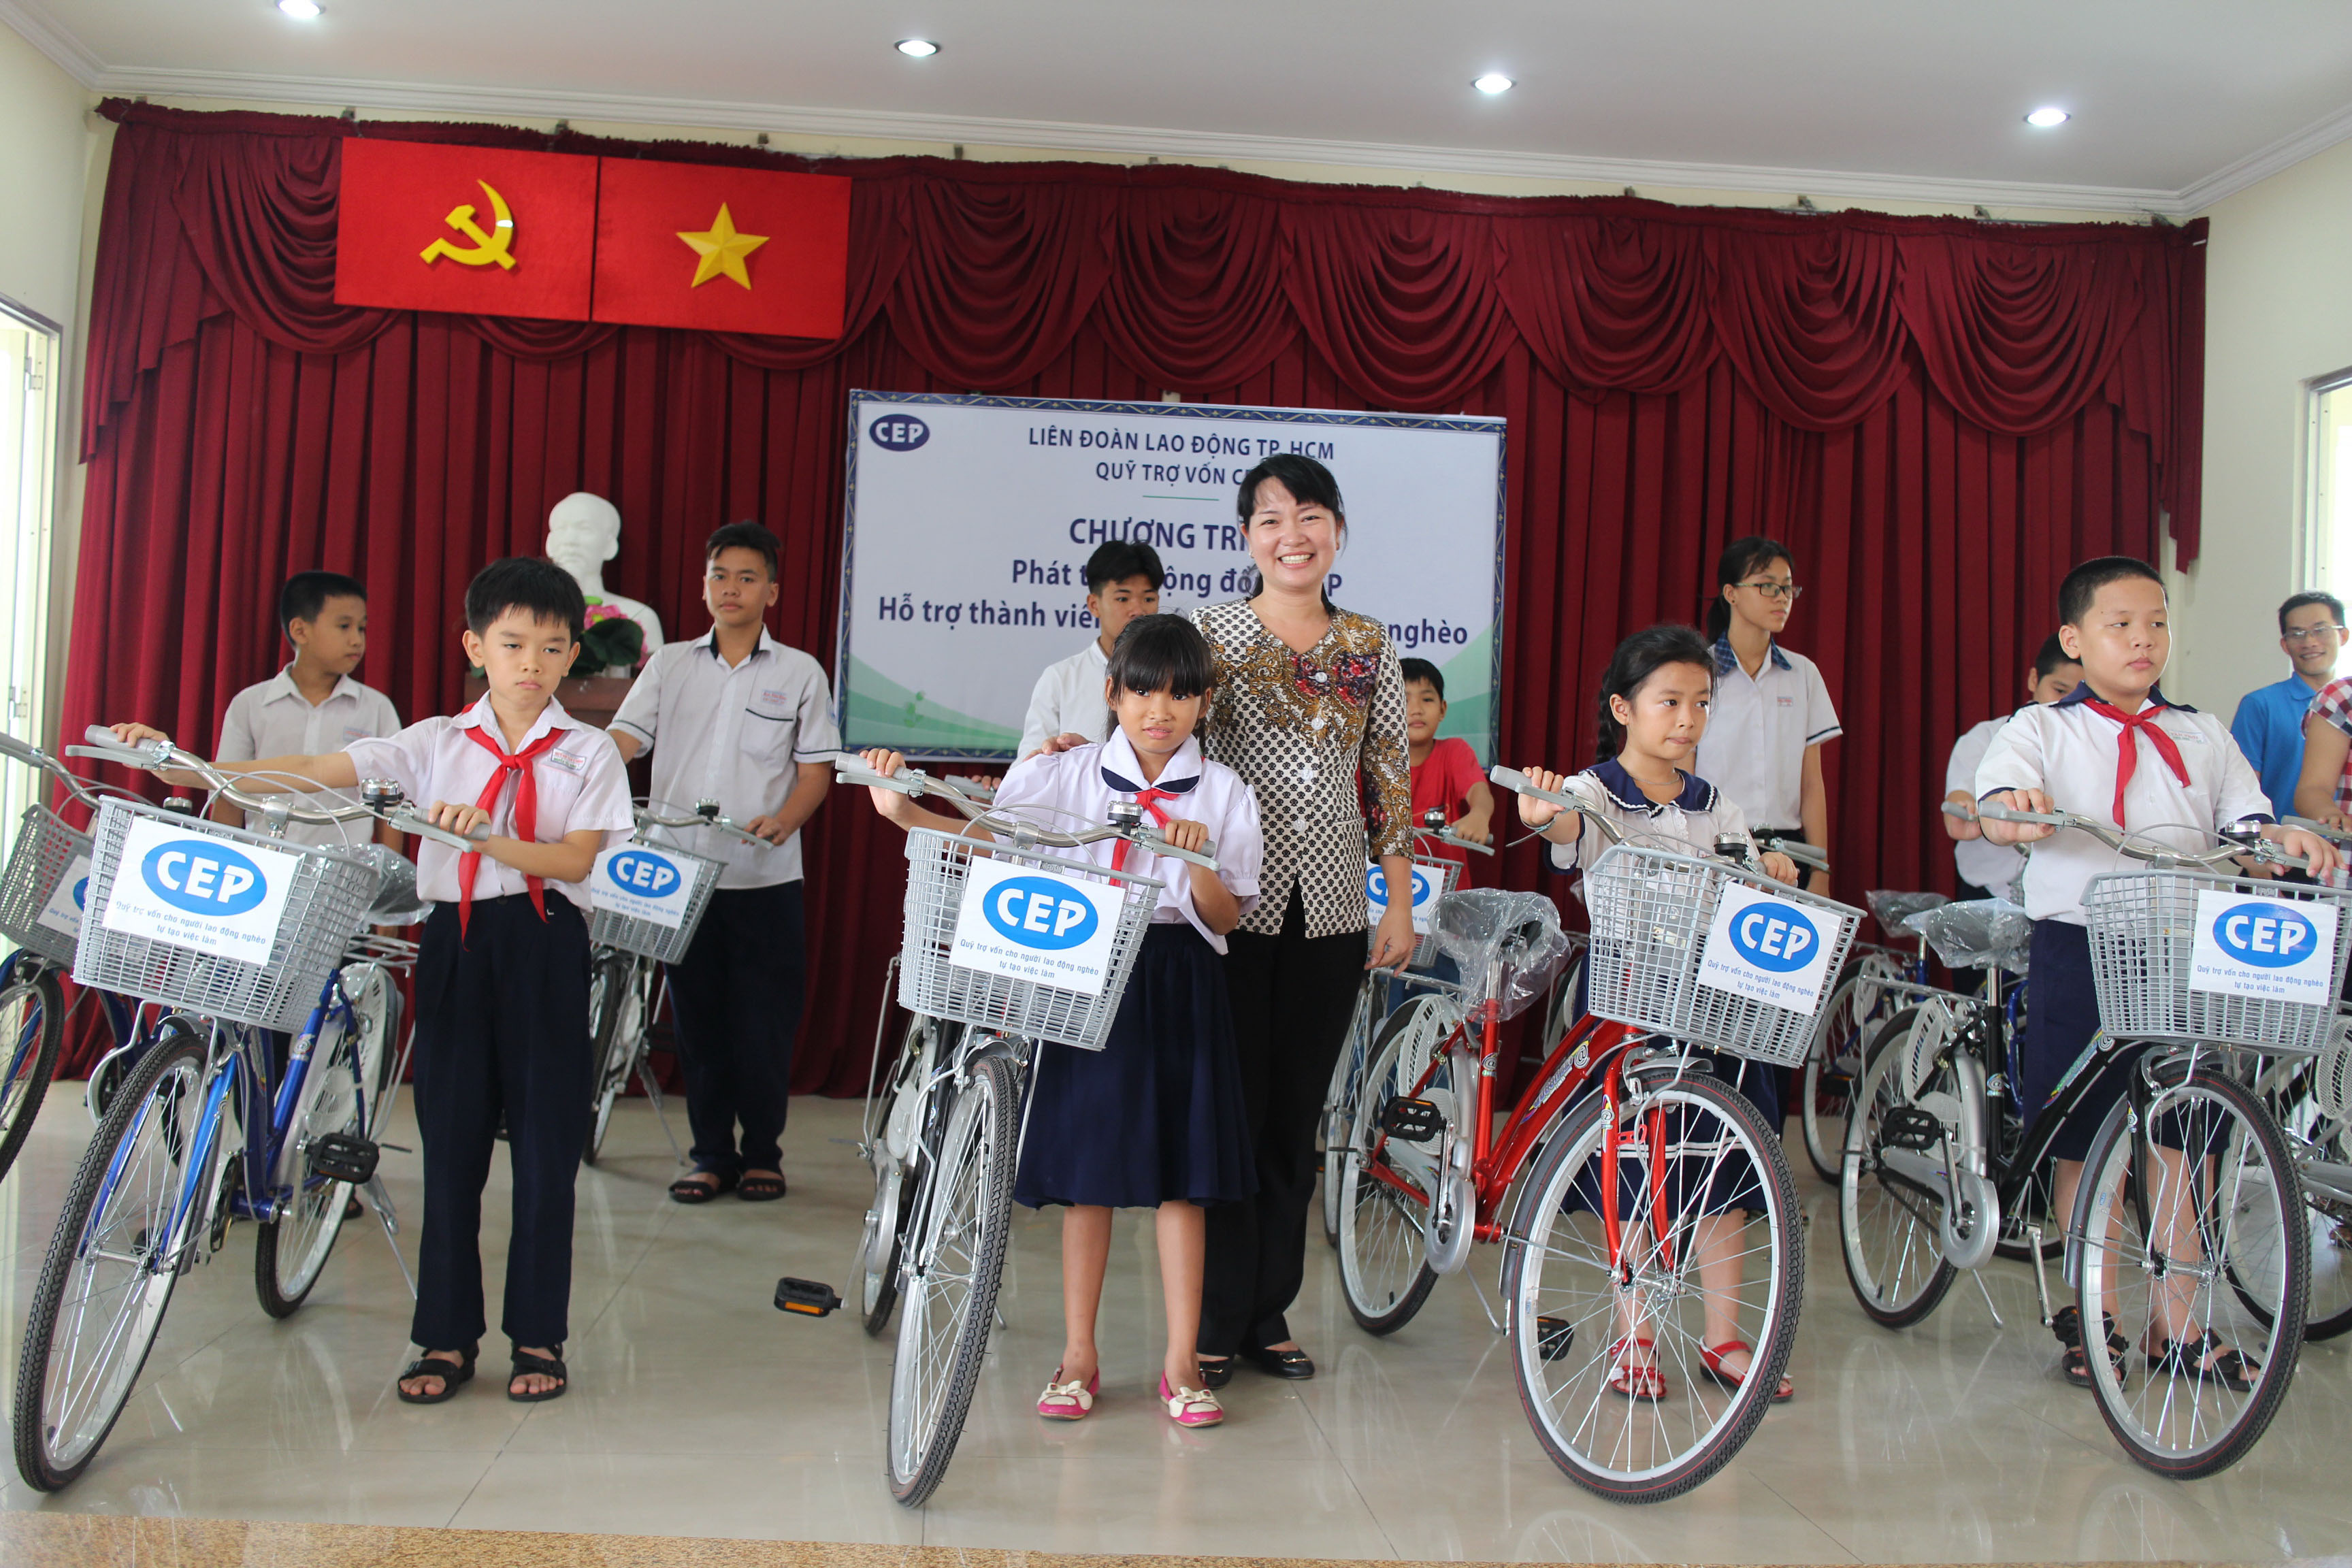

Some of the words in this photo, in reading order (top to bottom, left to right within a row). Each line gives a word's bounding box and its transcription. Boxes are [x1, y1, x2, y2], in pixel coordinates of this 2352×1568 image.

[875, 422, 924, 444] CEP
[1029, 425, 1072, 446] LIÊN
[1079, 428, 1138, 450] ĐOÀN
[1146, 434, 1184, 452] LAO
[1192, 434, 1250, 459] ĐỘNG
[1256, 439, 1280, 457] TP
[1290, 441, 1334, 460] HCM
[1096, 460, 1137, 480] QUỸ
[1143, 464, 1180, 487] TRỢ
[1186, 462, 1225, 485] VỐN
[1069, 517, 1194, 549] CHƯƠNG
[1013, 559, 1071, 586] Phát
[1162, 565, 1211, 598] ộng
[879, 593, 914, 622] Hỗ
[923, 600, 962, 630] trợ
[969, 599, 1046, 626] thành
[1388, 618, 1468, 649] nghèo
[157, 851, 255, 903] CEP
[617, 856, 674, 891] CEP
[1369, 872, 1423, 897] CP
[148, 909, 161, 918] vốn
[164, 913, 177, 922] cho
[180, 917, 202, 928] người
[205, 923, 217, 932] lao
[220, 927, 239, 939] động
[242, 932, 265, 944] nghèo
[996, 887, 1087, 937] CEP
[157, 925, 165, 934] tự
[167, 928, 180, 937] tạo
[184, 932, 199, 942] việc
[202, 936, 217, 945] làm
[1740, 913, 1811, 960] CEP
[2225, 915, 2306, 955] CEP
[960, 938, 975, 949] Quỹ
[977, 943, 987, 952] trợ
[990, 945, 1003, 955] vốn
[1005, 949, 1018, 958] cho
[1021, 953, 1041, 963] người
[1043, 957, 1054, 966] lao
[1057, 960, 1075, 971] động
[1077, 964, 1099, 975] nghèo
[1009, 962, 1021, 971] tạo
[1024, 966, 1039, 975] việc
[1041, 969, 1055, 979] làm
[1708, 960, 1719, 970] Quỹ
[1720, 964, 1729, 973] trợ
[1731, 966, 1742, 976] vốn
[1742, 970, 1753, 979] cho
[1754, 975, 1771, 983] người
[1772, 978, 1781, 987] lao
[1782, 982, 1796, 993] động
[1797, 986, 1814, 997] nghèo
[1737, 981, 1744, 989] tự
[1745, 983, 1754, 992] tạo
[1756, 987, 1768, 996] việc
[1769, 990, 1780, 999] làm
[2197, 965, 2210, 975] Quỹ
[2224, 968, 2236, 977] vốn
[2252, 973, 2271, 981] người
[2285, 976, 2302, 986] động
[2304, 978, 2323, 987] nghèo
[2234, 981, 2241, 989] tự
[2243, 982, 2254, 990] tạo
[2256, 984, 2270, 992] việc
[2272, 985, 2285, 994] làm
